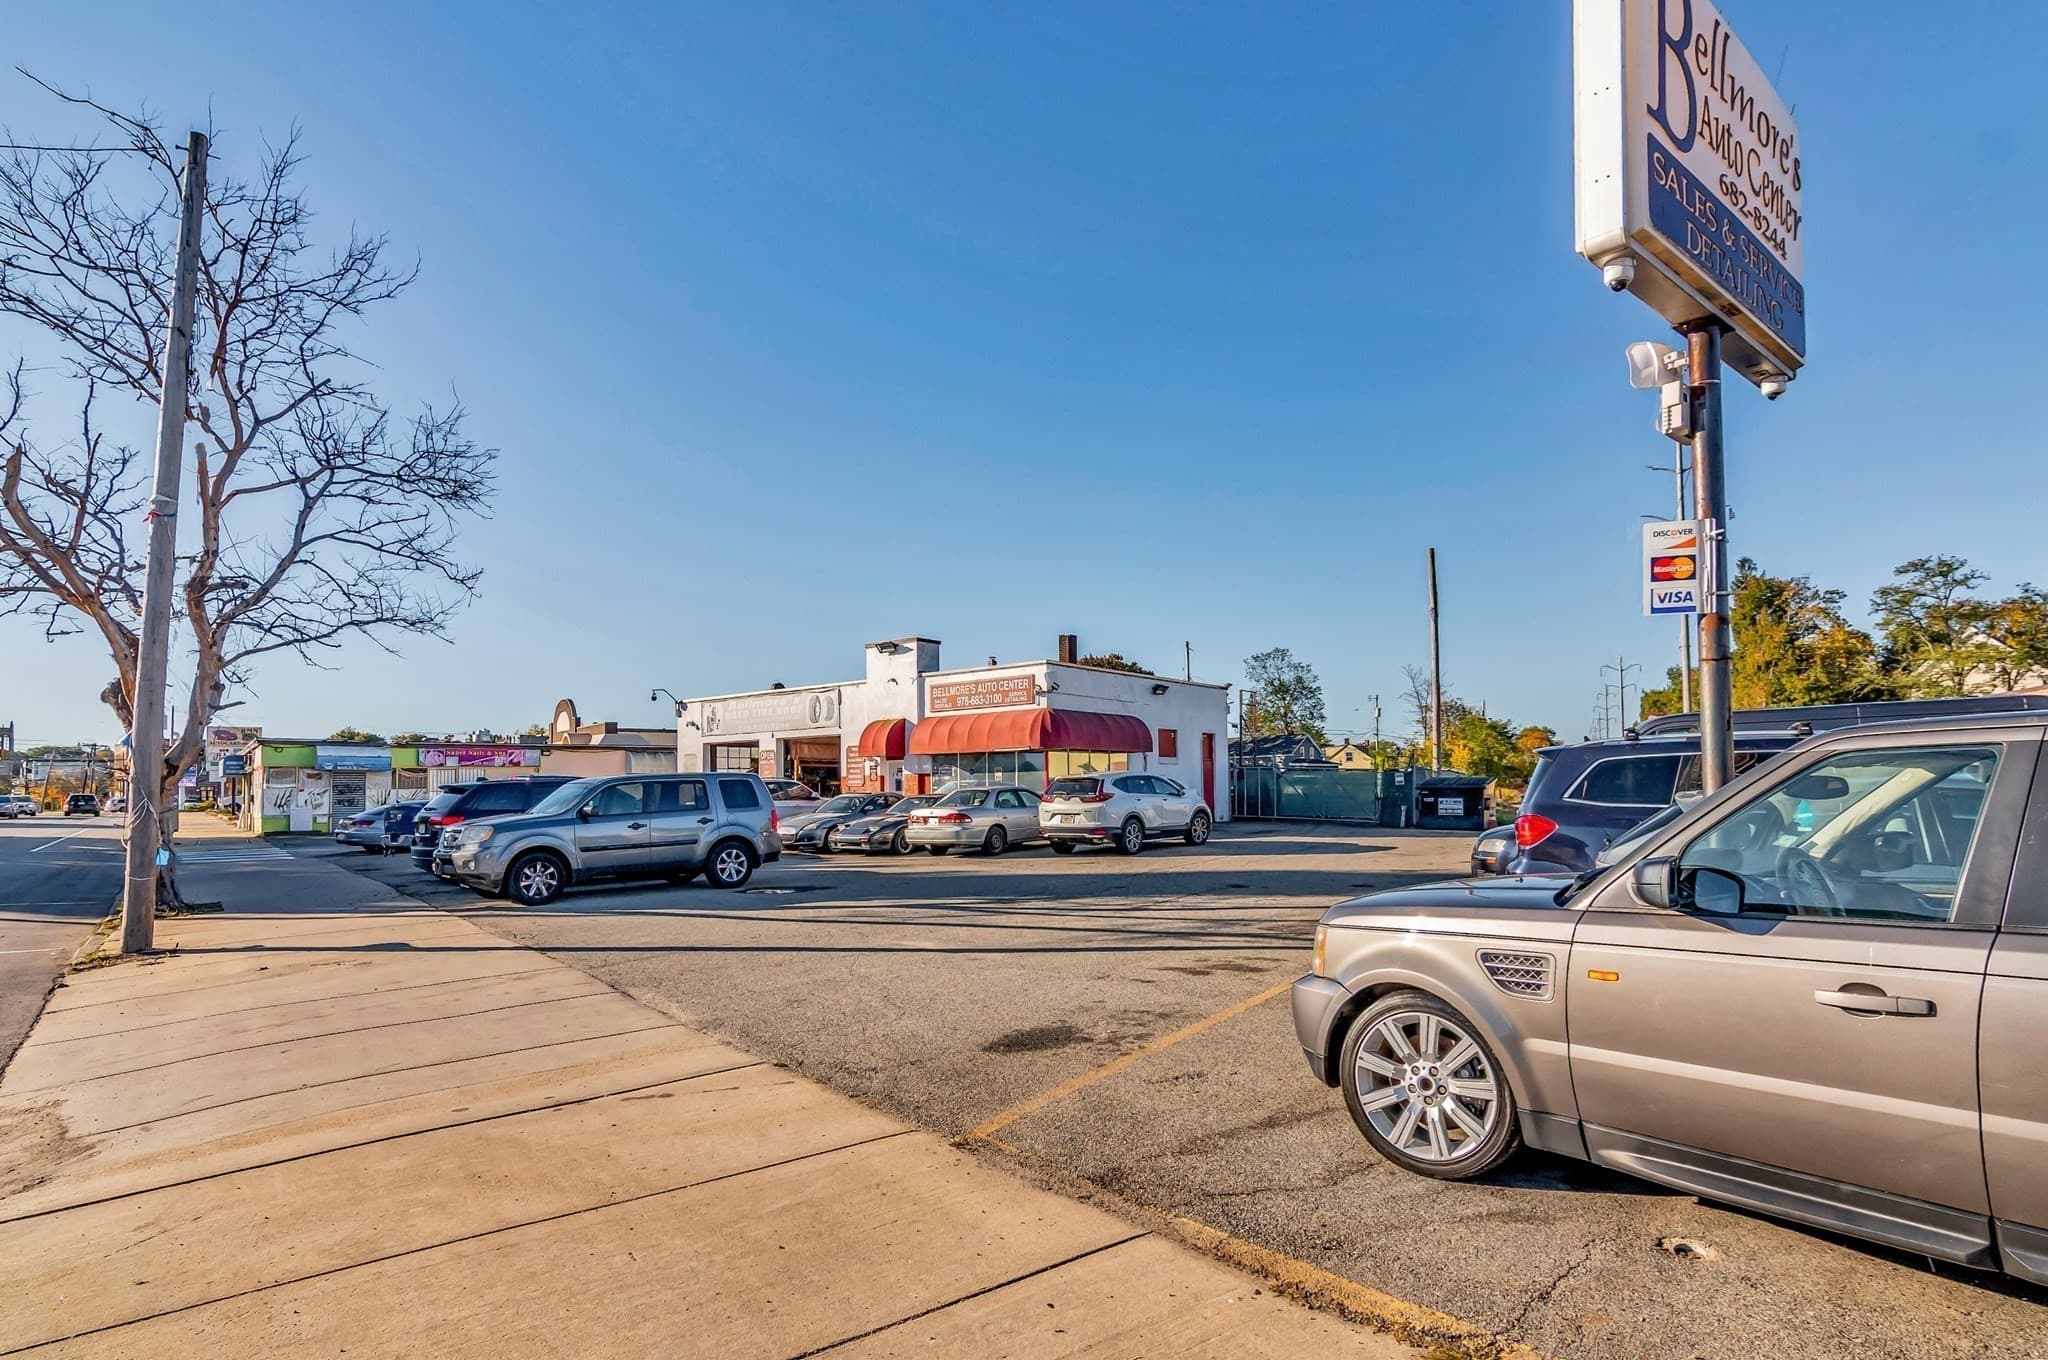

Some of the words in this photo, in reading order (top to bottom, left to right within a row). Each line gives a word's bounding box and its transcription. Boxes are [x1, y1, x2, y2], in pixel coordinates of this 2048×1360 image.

[1646, 0, 1801, 191] Bellmore's
[1698, 95, 1743, 177] Auto
[1747, 148, 1802, 241] Center
[1652, 151, 1718, 232] SALES
[1721, 218, 1737, 250] &
[1740, 235, 1802, 317] SERVICE
[1719, 173, 1787, 260] 682-8244
[1686, 219, 1784, 329] DETAILING
[1652, 528, 1693, 537] DISCOVER
[1656, 591, 1694, 604] VISA
[932, 683, 976, 697] BELLMORE'S
[977, 681, 997, 693] AUTO
[998, 679, 1028, 691] CENTER
[760, 751, 775, 760] OPEN
